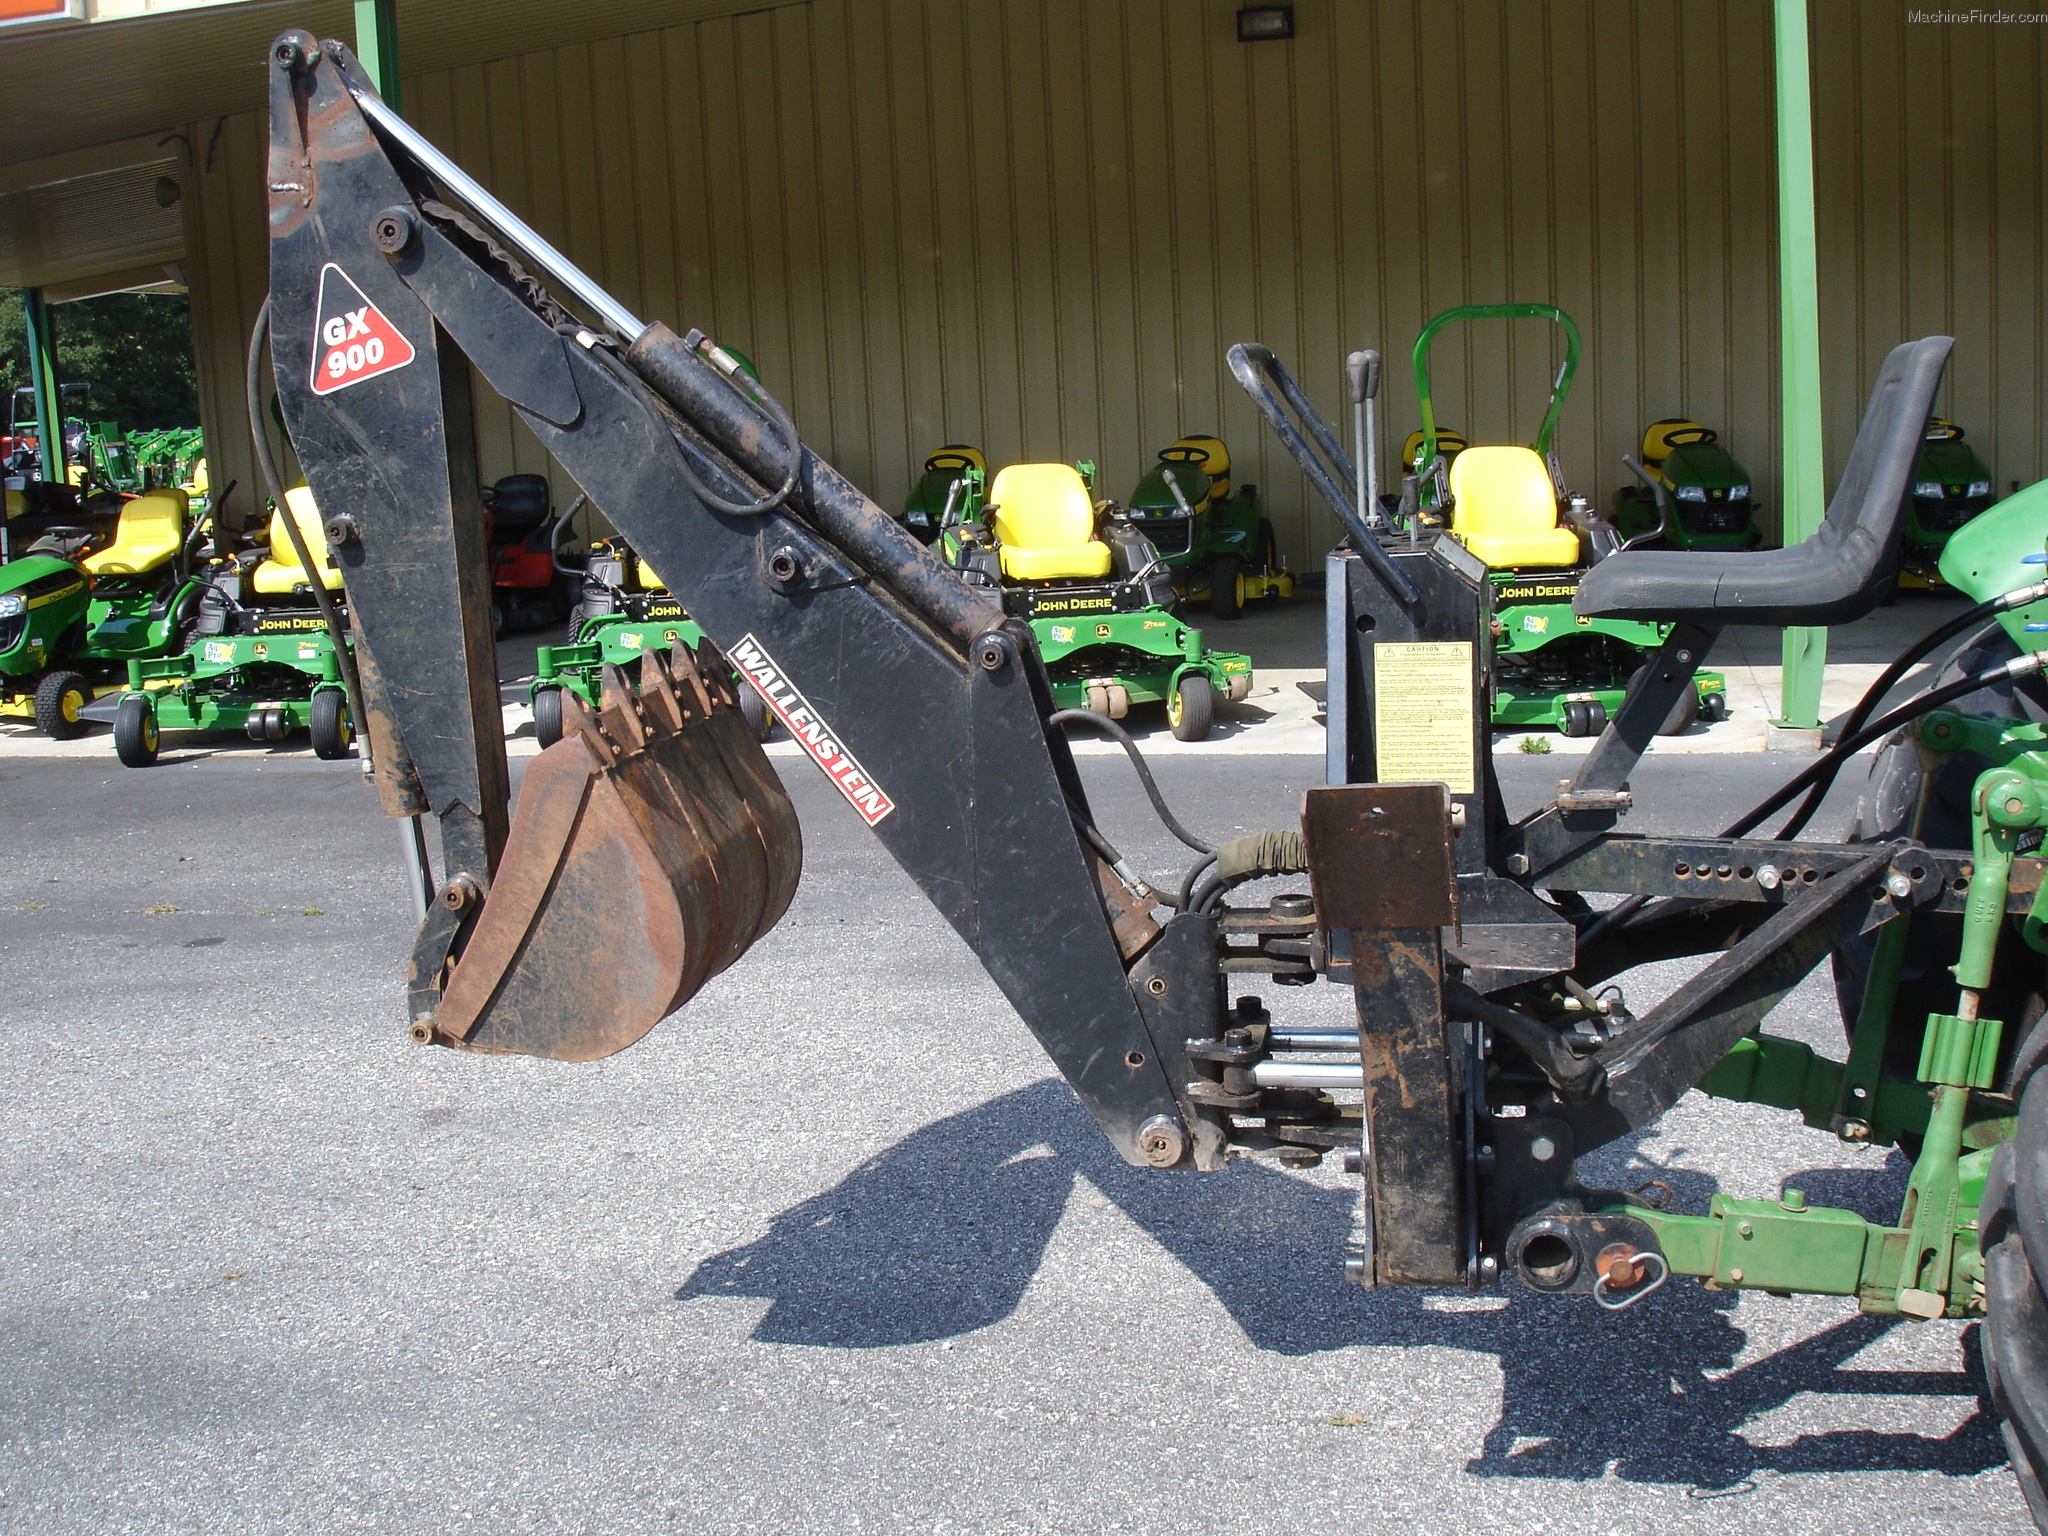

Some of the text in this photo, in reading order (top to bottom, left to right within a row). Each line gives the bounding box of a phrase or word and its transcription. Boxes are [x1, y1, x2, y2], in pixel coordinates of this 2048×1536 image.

[323, 306, 372, 347] GX
[327, 337, 385, 379] 900
[1499, 585, 1579, 599] JOHN DEERE
[648, 605, 681, 617] JOHN
[1034, 598, 1112, 612] JOHN DEERE
[259, 619, 291, 630] JOHN
[734, 641, 887, 816] WALLENSTEIN
